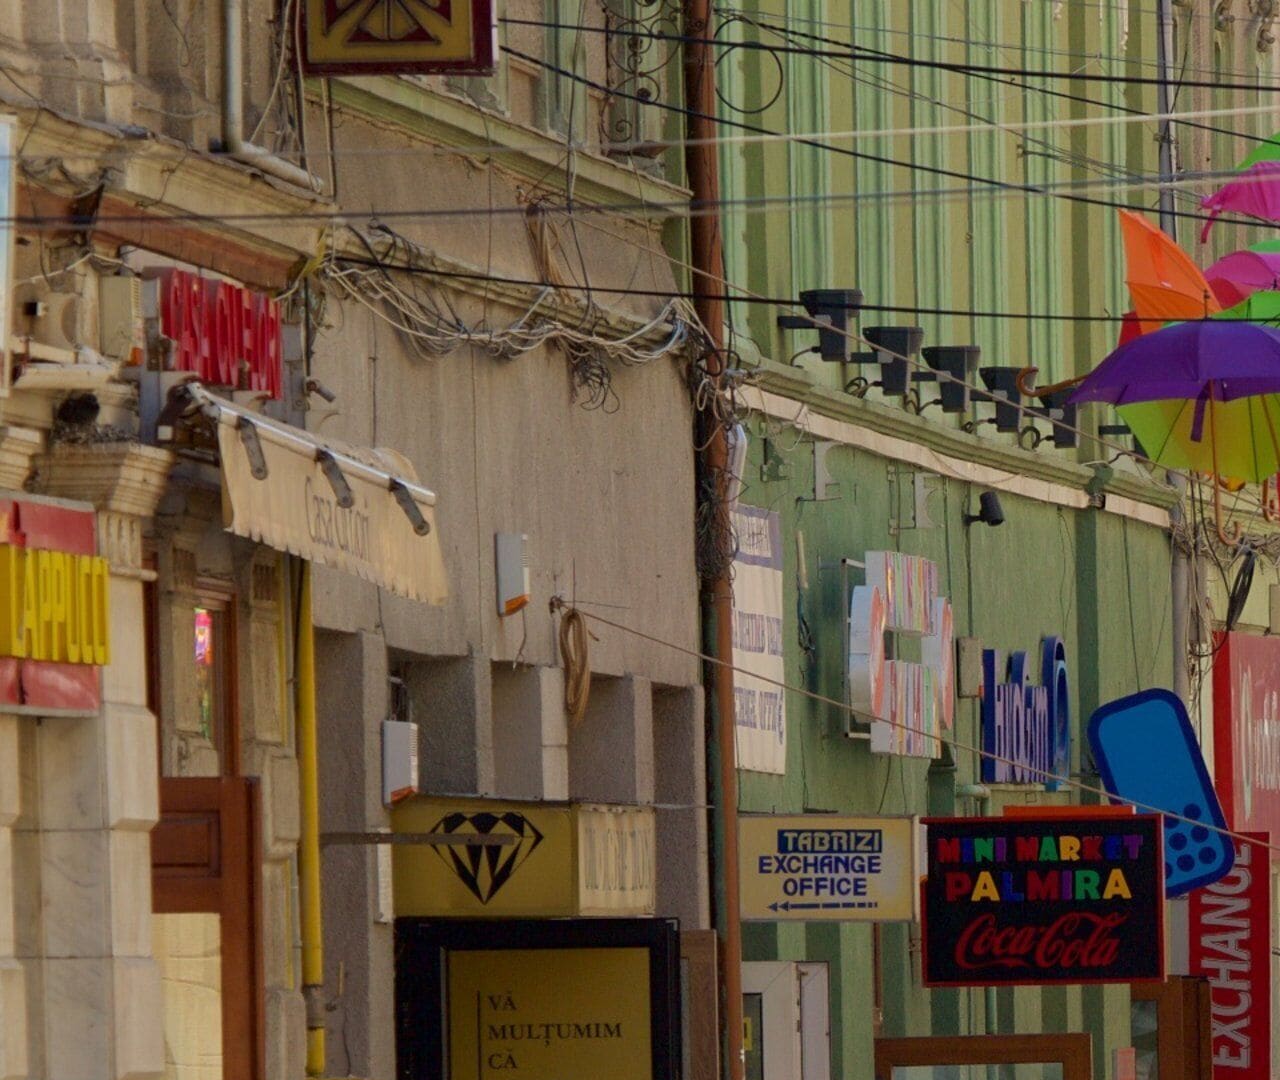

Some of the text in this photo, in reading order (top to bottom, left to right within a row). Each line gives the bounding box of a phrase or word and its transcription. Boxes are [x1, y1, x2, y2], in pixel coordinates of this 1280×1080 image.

[783, 830, 881, 853] TABRIZI
[937, 834, 1144, 862] MINI MARKET
[757, 853, 882, 876] EXCHANGE
[782, 876, 868, 898] OFFICE
[945, 868, 1133, 902] PALMIRA
[487, 989, 518, 1012] VĂ
[487, 1022, 623, 1046] MULȚUMIM
[487, 1048, 518, 1071] CĂ
